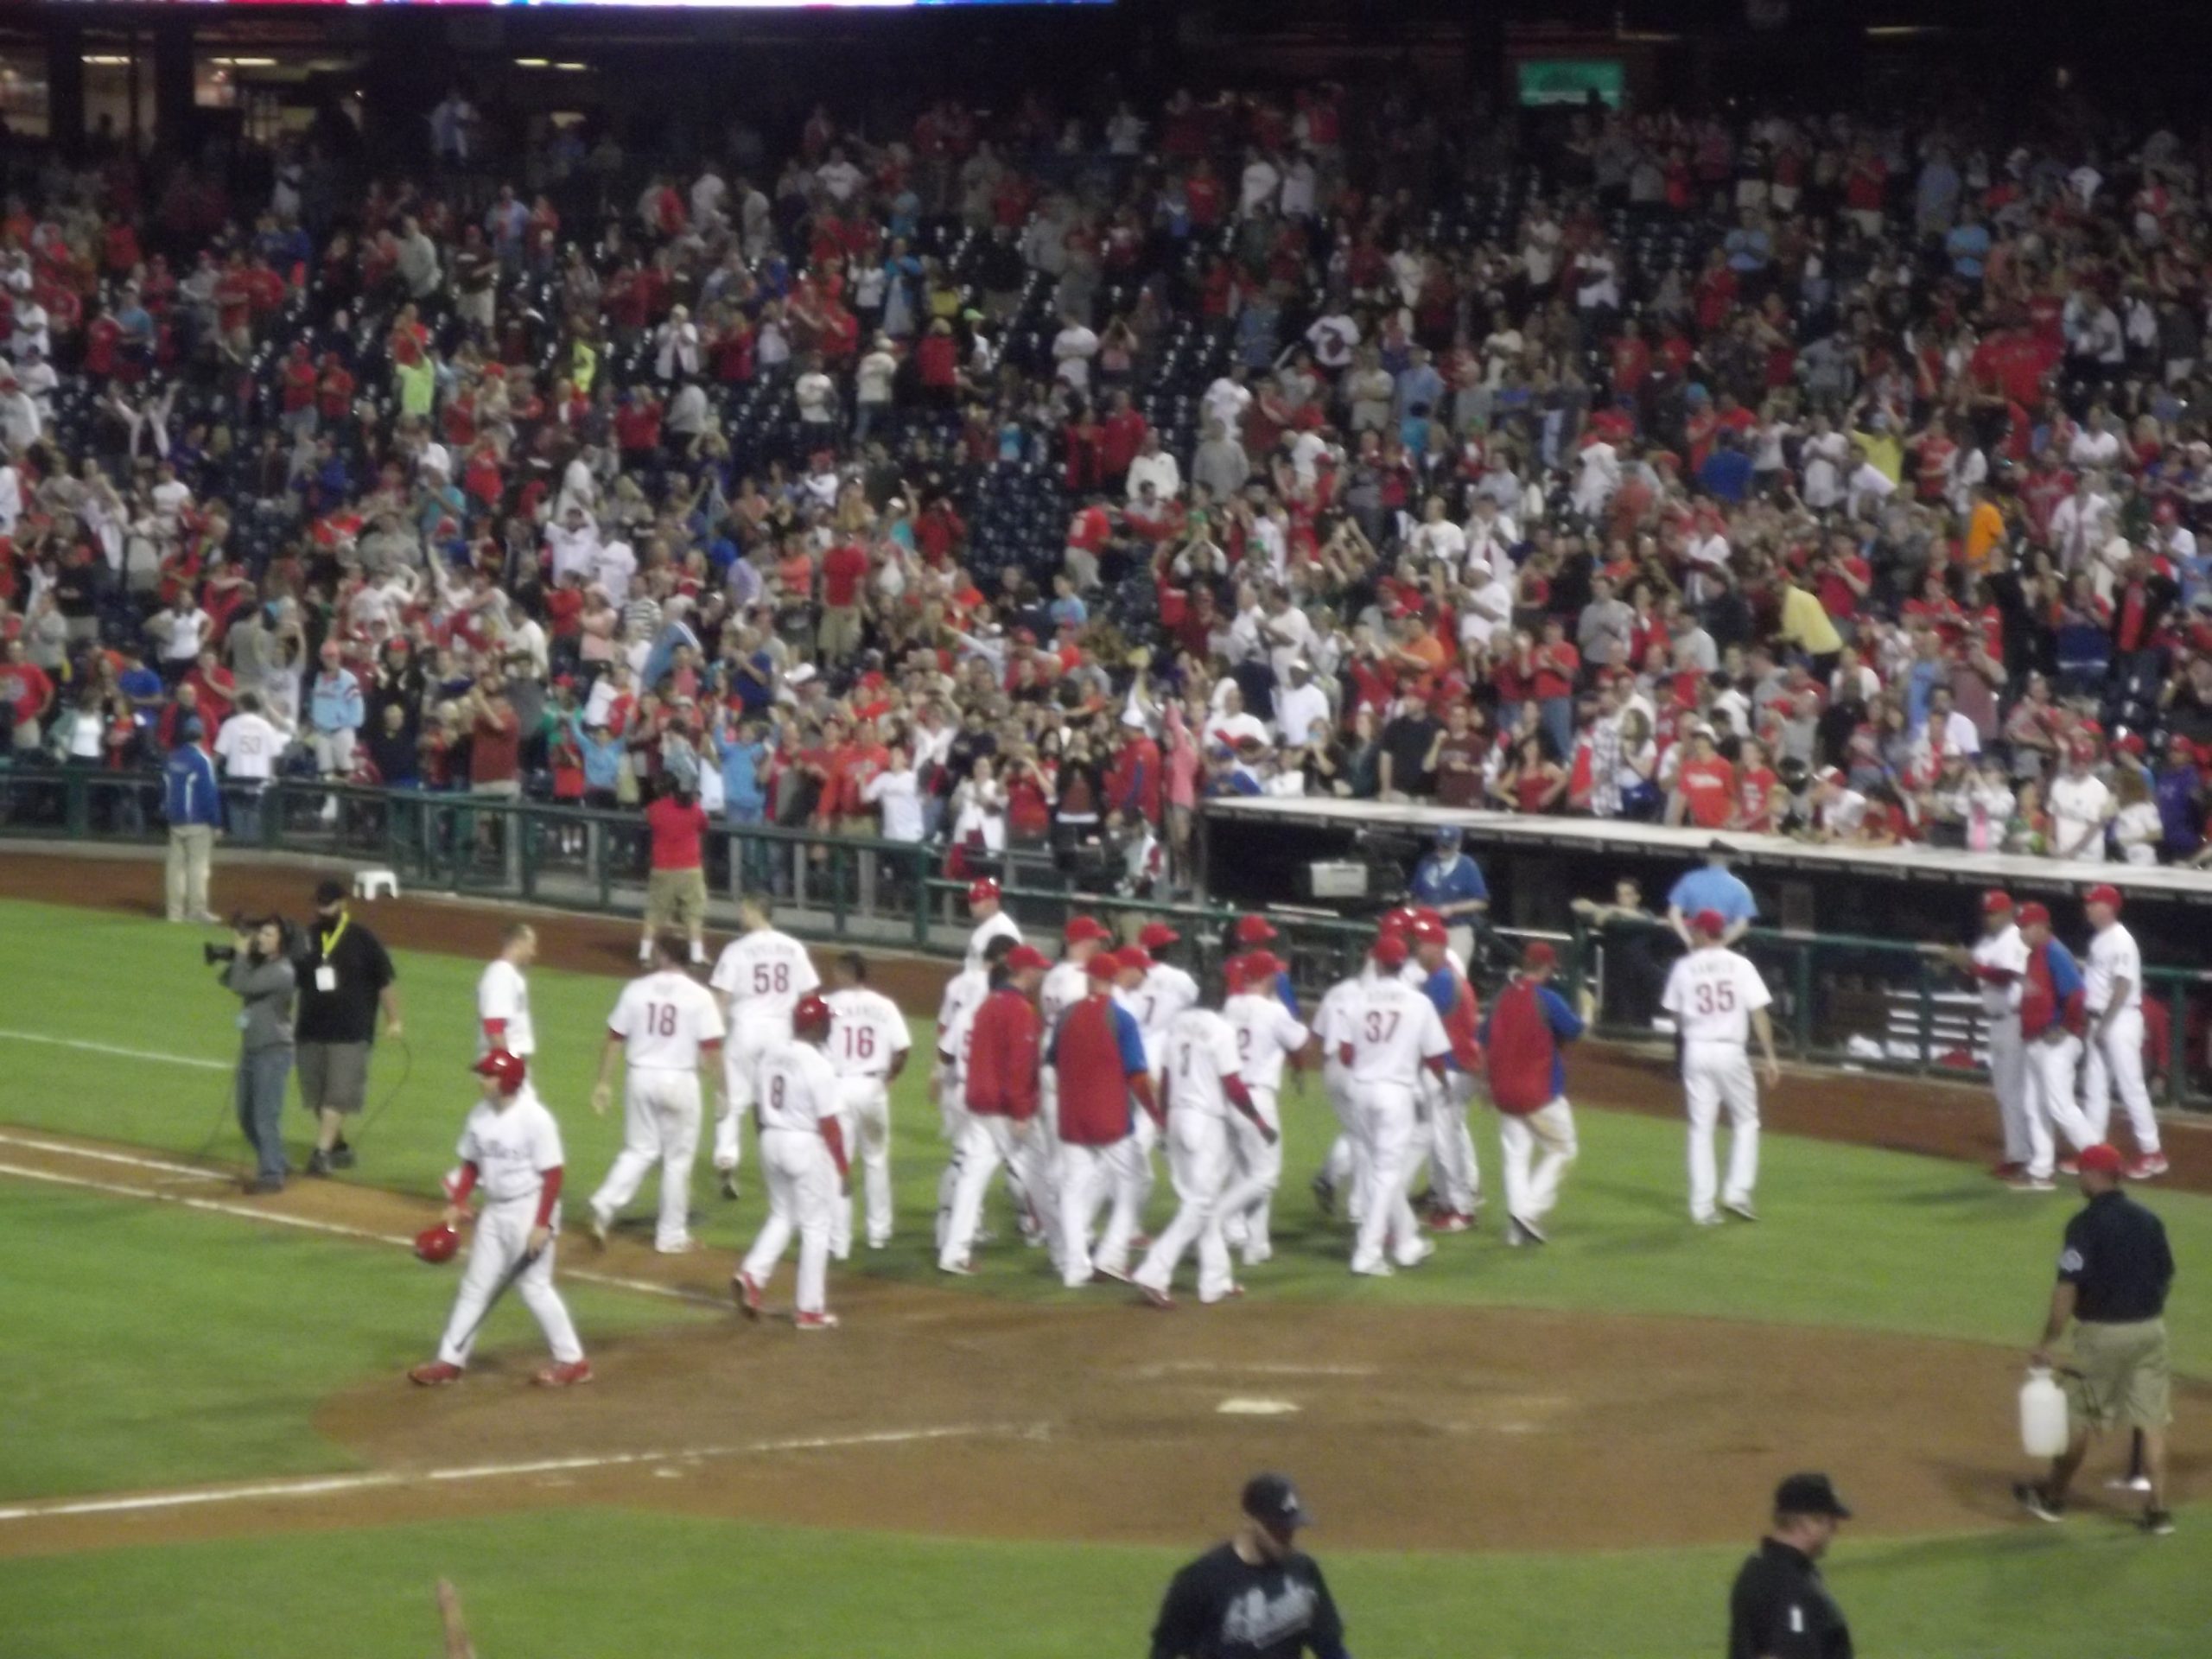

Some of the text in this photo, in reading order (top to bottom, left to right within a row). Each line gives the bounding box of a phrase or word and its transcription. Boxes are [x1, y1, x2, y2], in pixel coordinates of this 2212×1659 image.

[753, 963, 790, 995] 58
[1696, 981, 1735, 1015] 35
[647, 1001, 677, 1037] 18
[1366, 1009, 1401, 1044] 37
[843, 1026, 875, 1059] 16
[770, 1074, 786, 1111] 8
